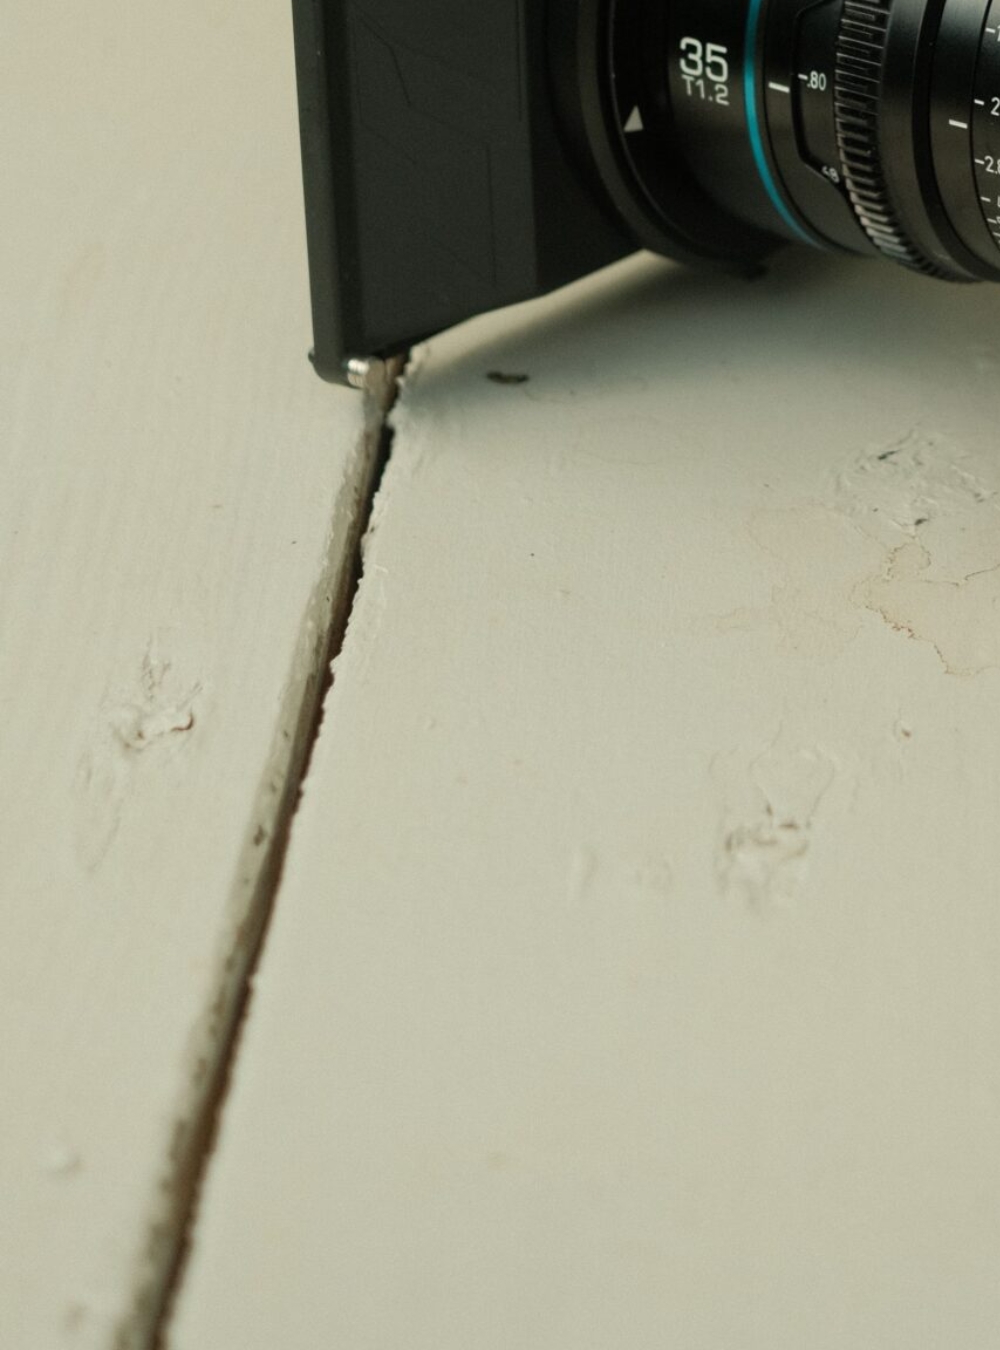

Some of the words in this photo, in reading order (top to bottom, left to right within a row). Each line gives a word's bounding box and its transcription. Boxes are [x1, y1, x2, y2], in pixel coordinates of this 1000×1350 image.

[679, 36, 729, 83] 35
[681, 74, 730, 106] T1.2
[990, 96, 1000, 117] 2
